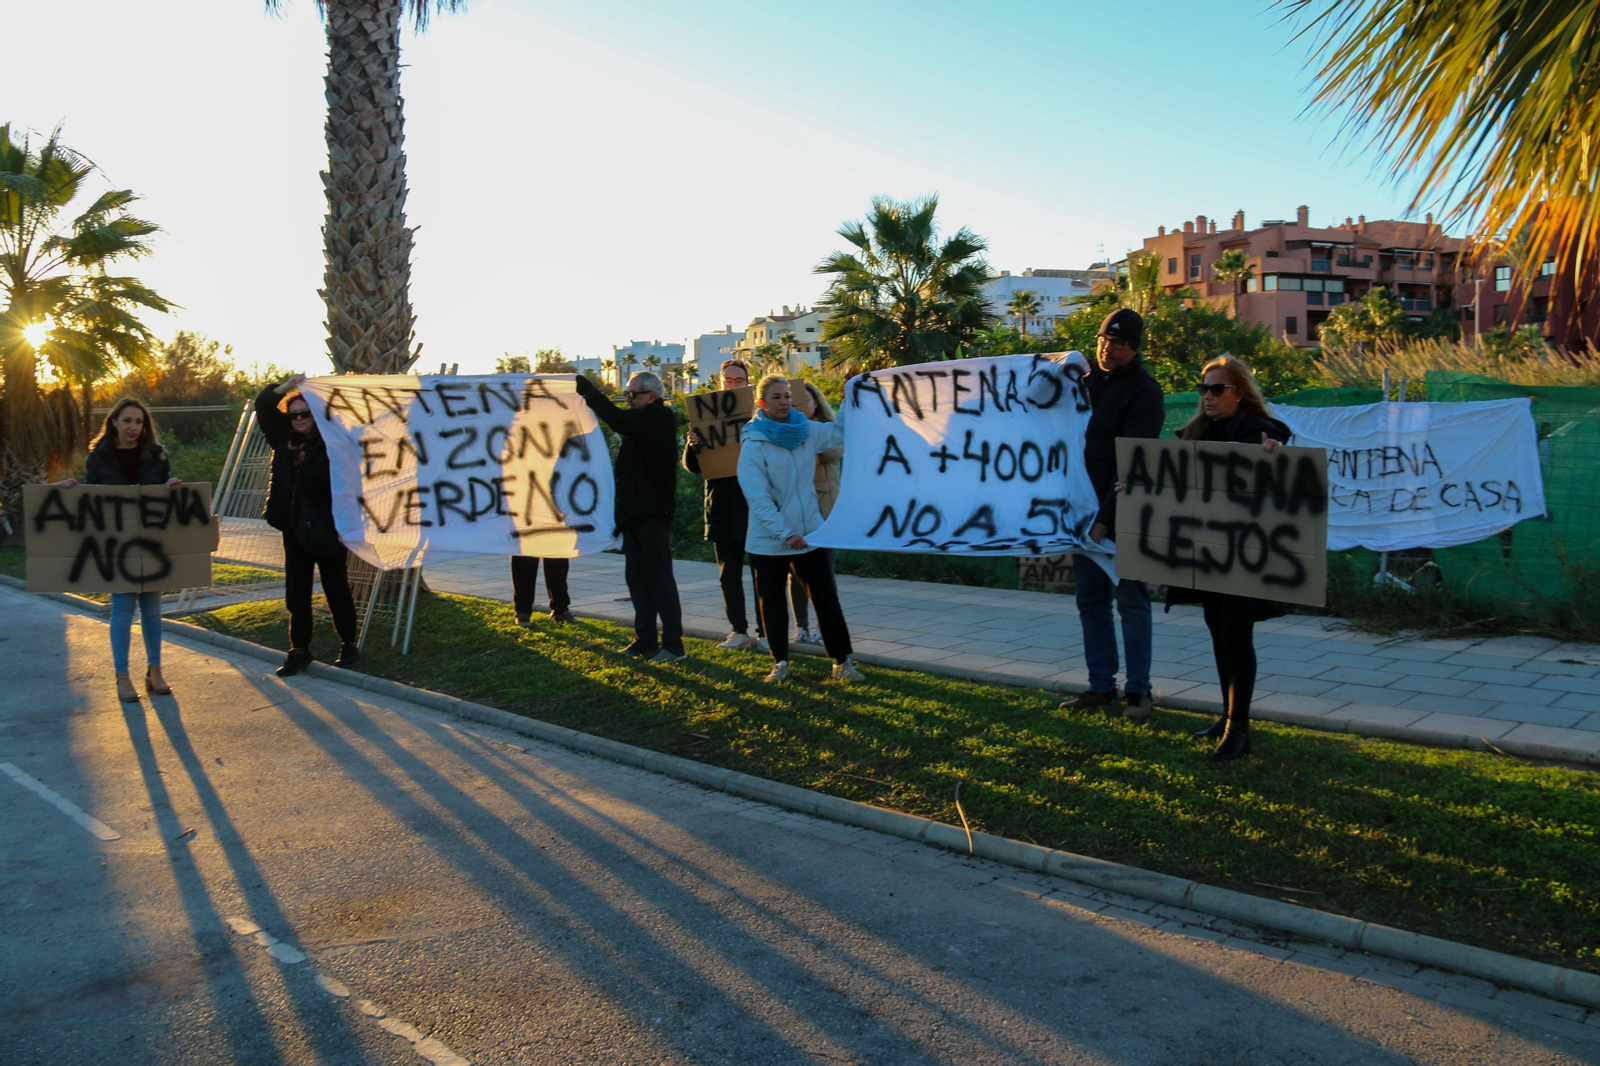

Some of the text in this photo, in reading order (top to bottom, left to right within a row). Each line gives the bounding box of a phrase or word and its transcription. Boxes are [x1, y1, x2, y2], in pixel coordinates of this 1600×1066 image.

[325, 378, 568, 425] ANTENA
[695, 390, 737, 419] NO
[852, 365, 1028, 419] ANTENA
[359, 419, 591, 479] EN ZONA
[878, 434, 911, 475] A
[1328, 441, 1443, 480] ANTENA
[357, 470, 598, 533] VERDE NO
[1124, 445, 1325, 517] ANTENA
[1390, 486, 1431, 513] DE
[1440, 480, 1522, 514] CASA
[33, 487, 209, 532] ANTENA
[866, 498, 941, 538] NO
[953, 504, 997, 538] A
[69, 536, 172, 583] NO
[1139, 504, 1305, 588] LEJOS
